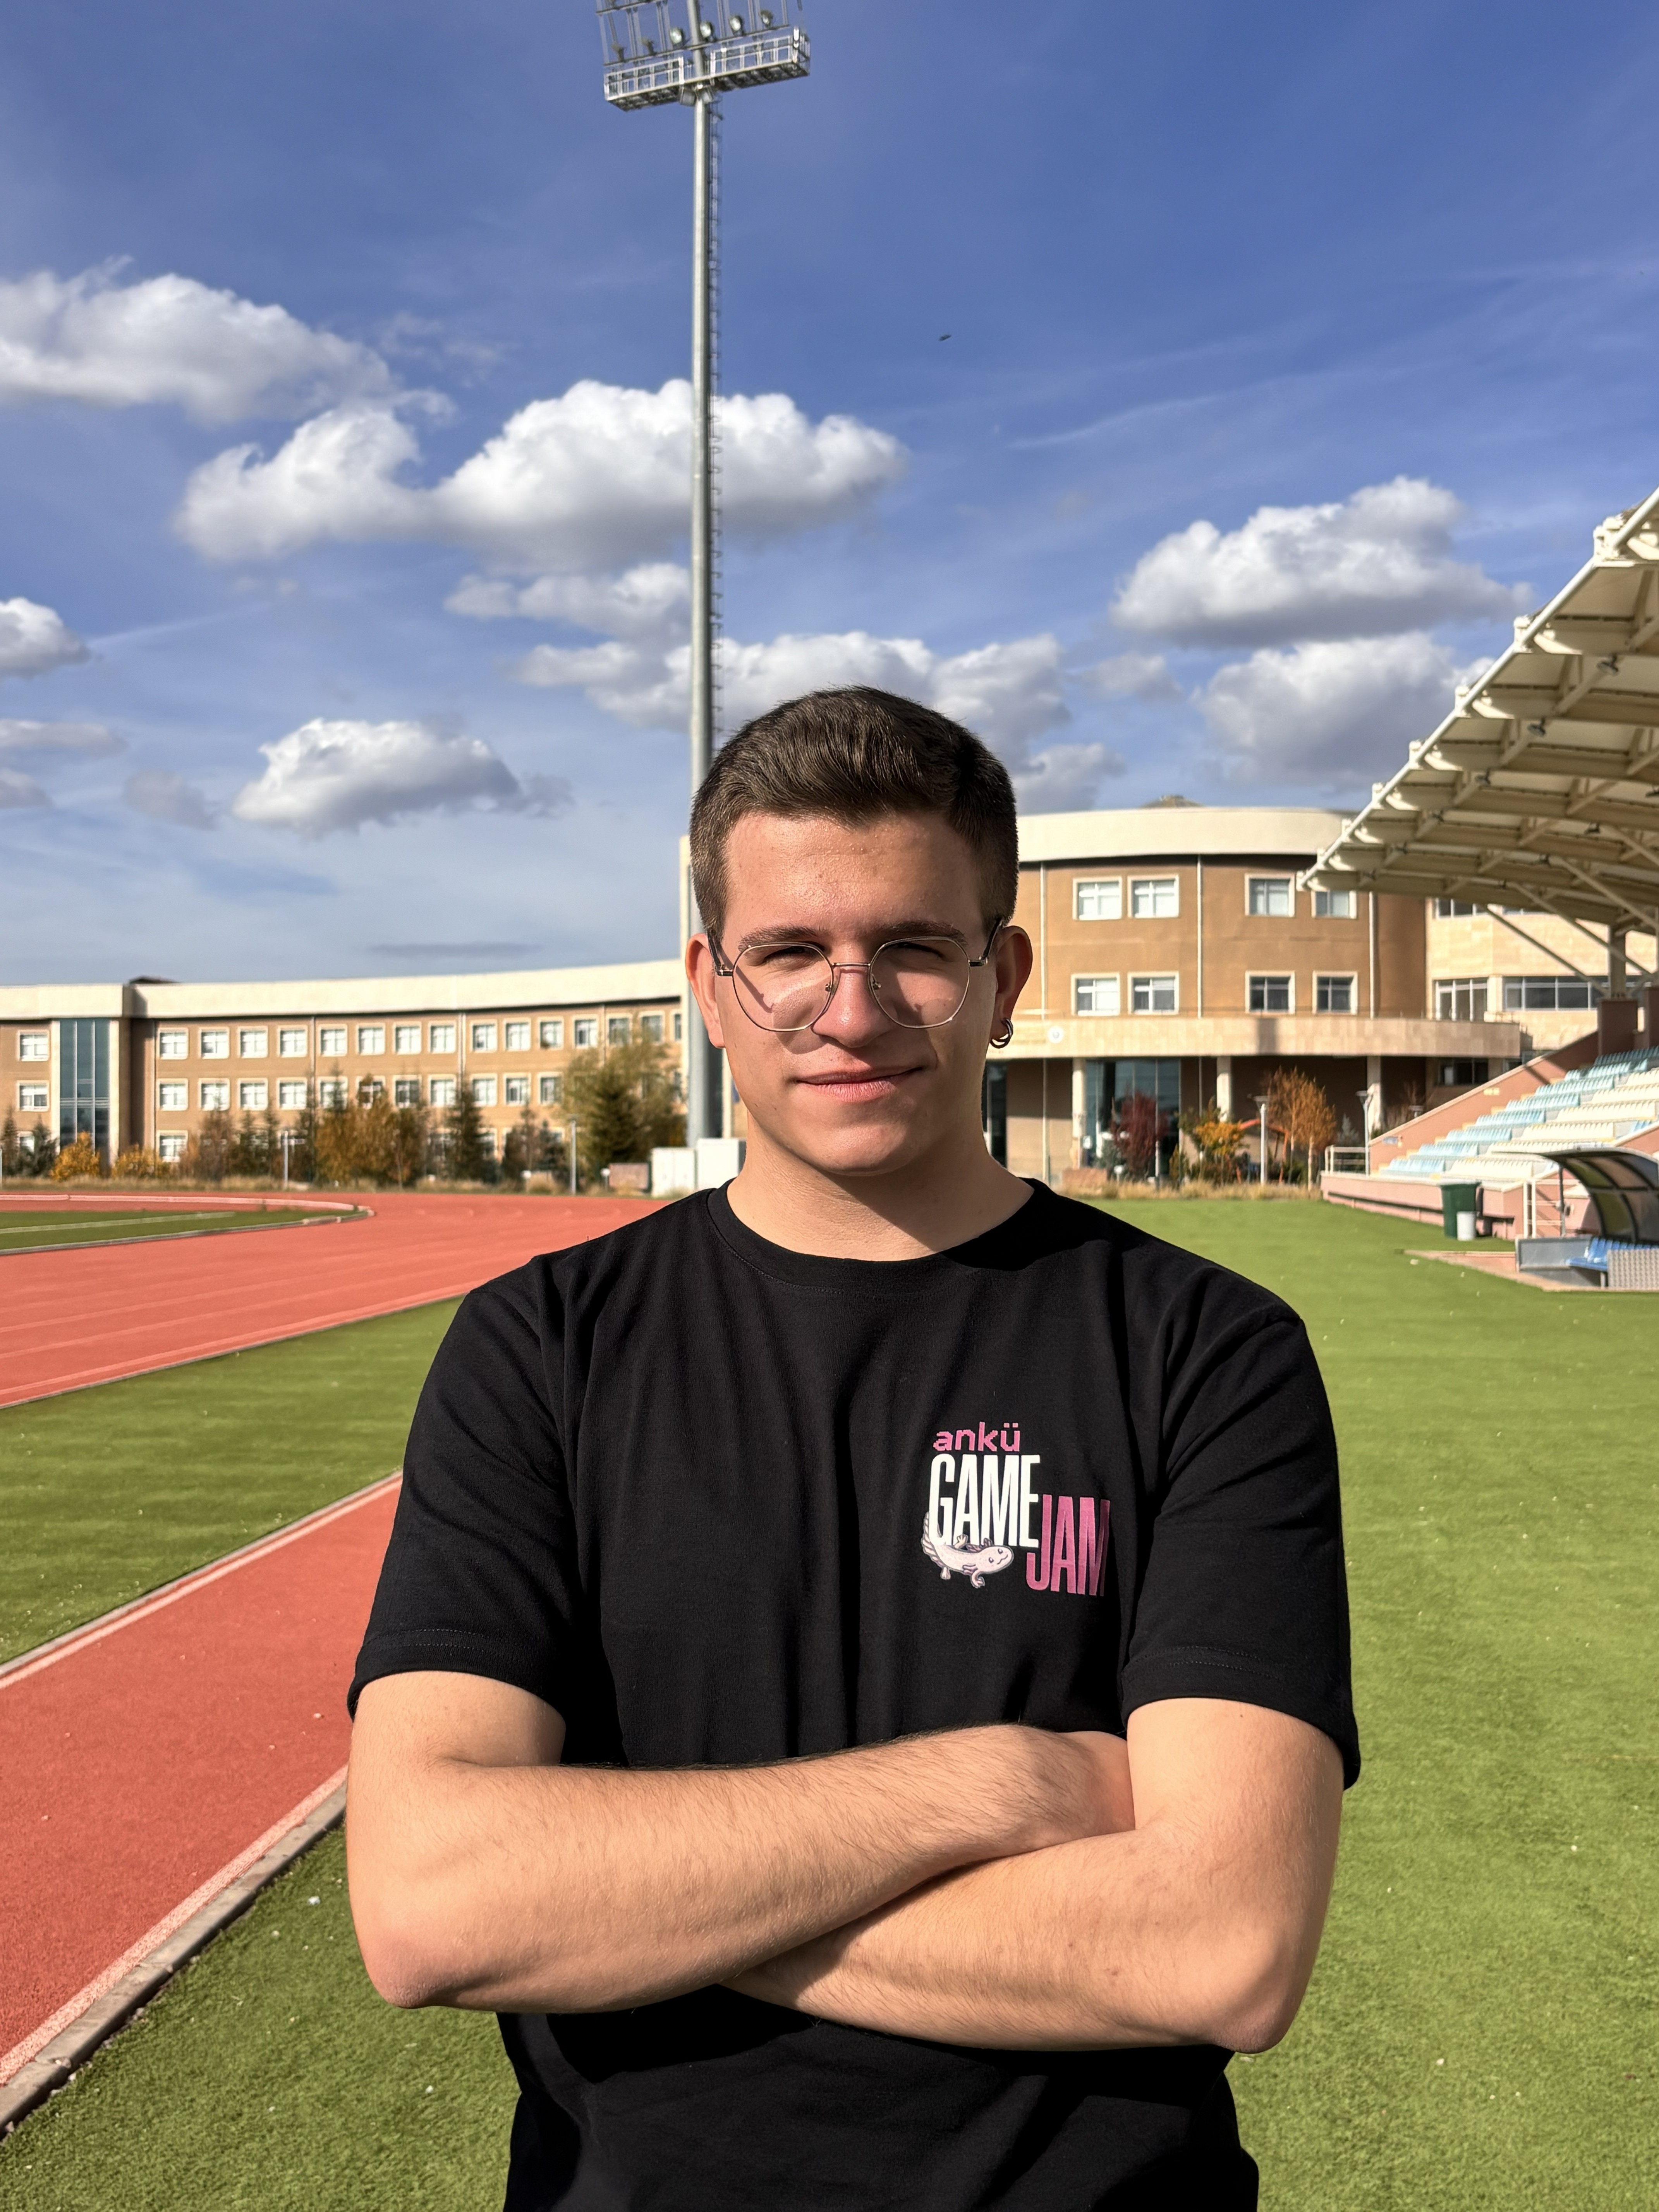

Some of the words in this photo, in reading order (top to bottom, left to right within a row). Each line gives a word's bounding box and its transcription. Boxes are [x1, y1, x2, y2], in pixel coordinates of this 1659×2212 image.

[933, 1422, 1020, 1452] ankü
[929, 1453, 1040, 1548] GAME
[1026, 1494, 1110, 1596] JAM
